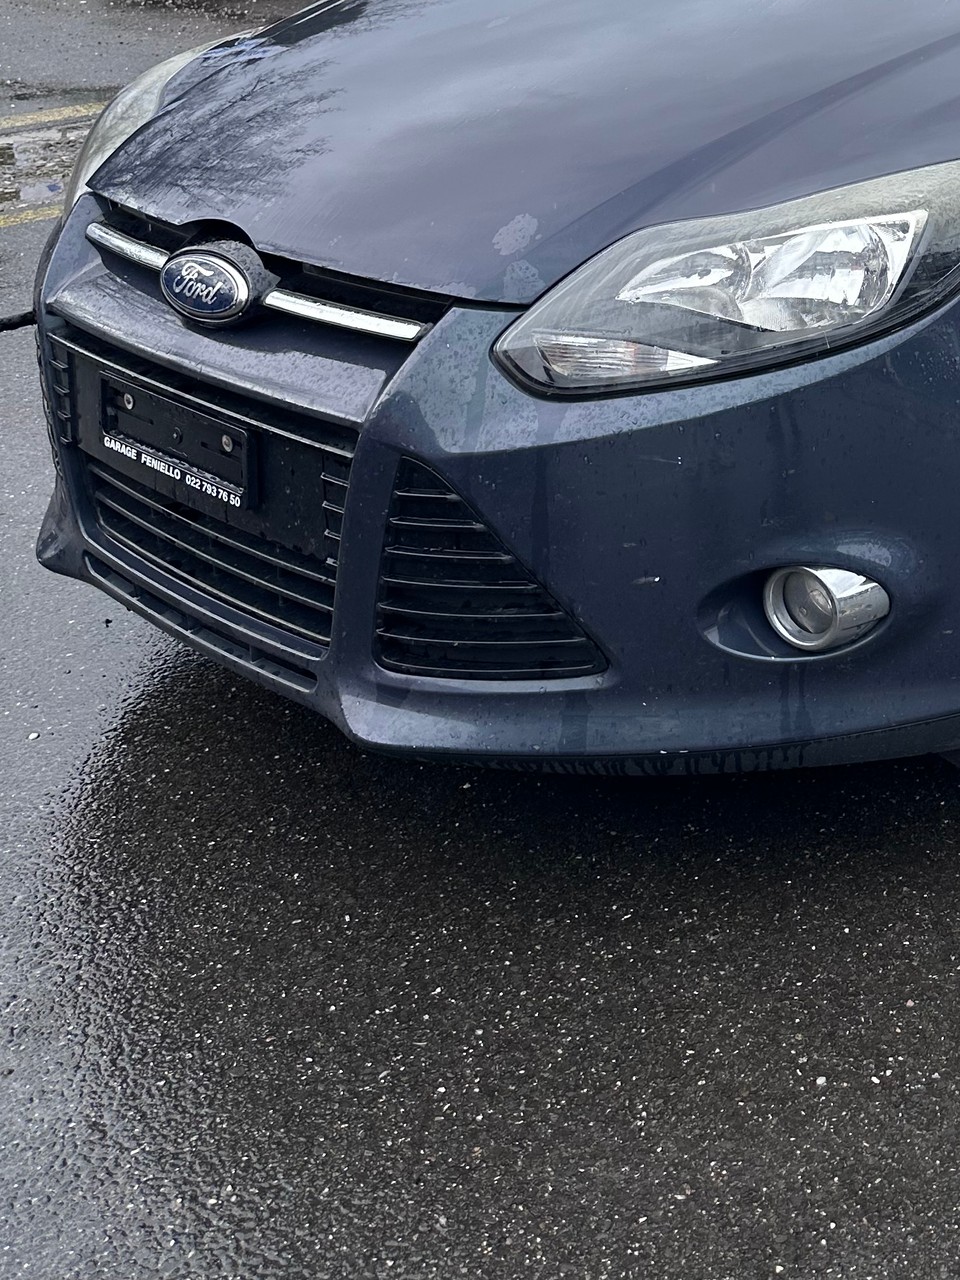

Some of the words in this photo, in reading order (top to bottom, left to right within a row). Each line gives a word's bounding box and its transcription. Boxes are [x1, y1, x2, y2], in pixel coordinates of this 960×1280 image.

[173, 262, 224, 305] Ford
[103, 436, 137, 460] GARAGE
[141, 453, 181, 480] FENIELLO
[185, 474, 201, 491] 022
[202, 481, 217, 497] 793
[217, 488, 229, 503] 76
[229, 495, 241, 508] 50
